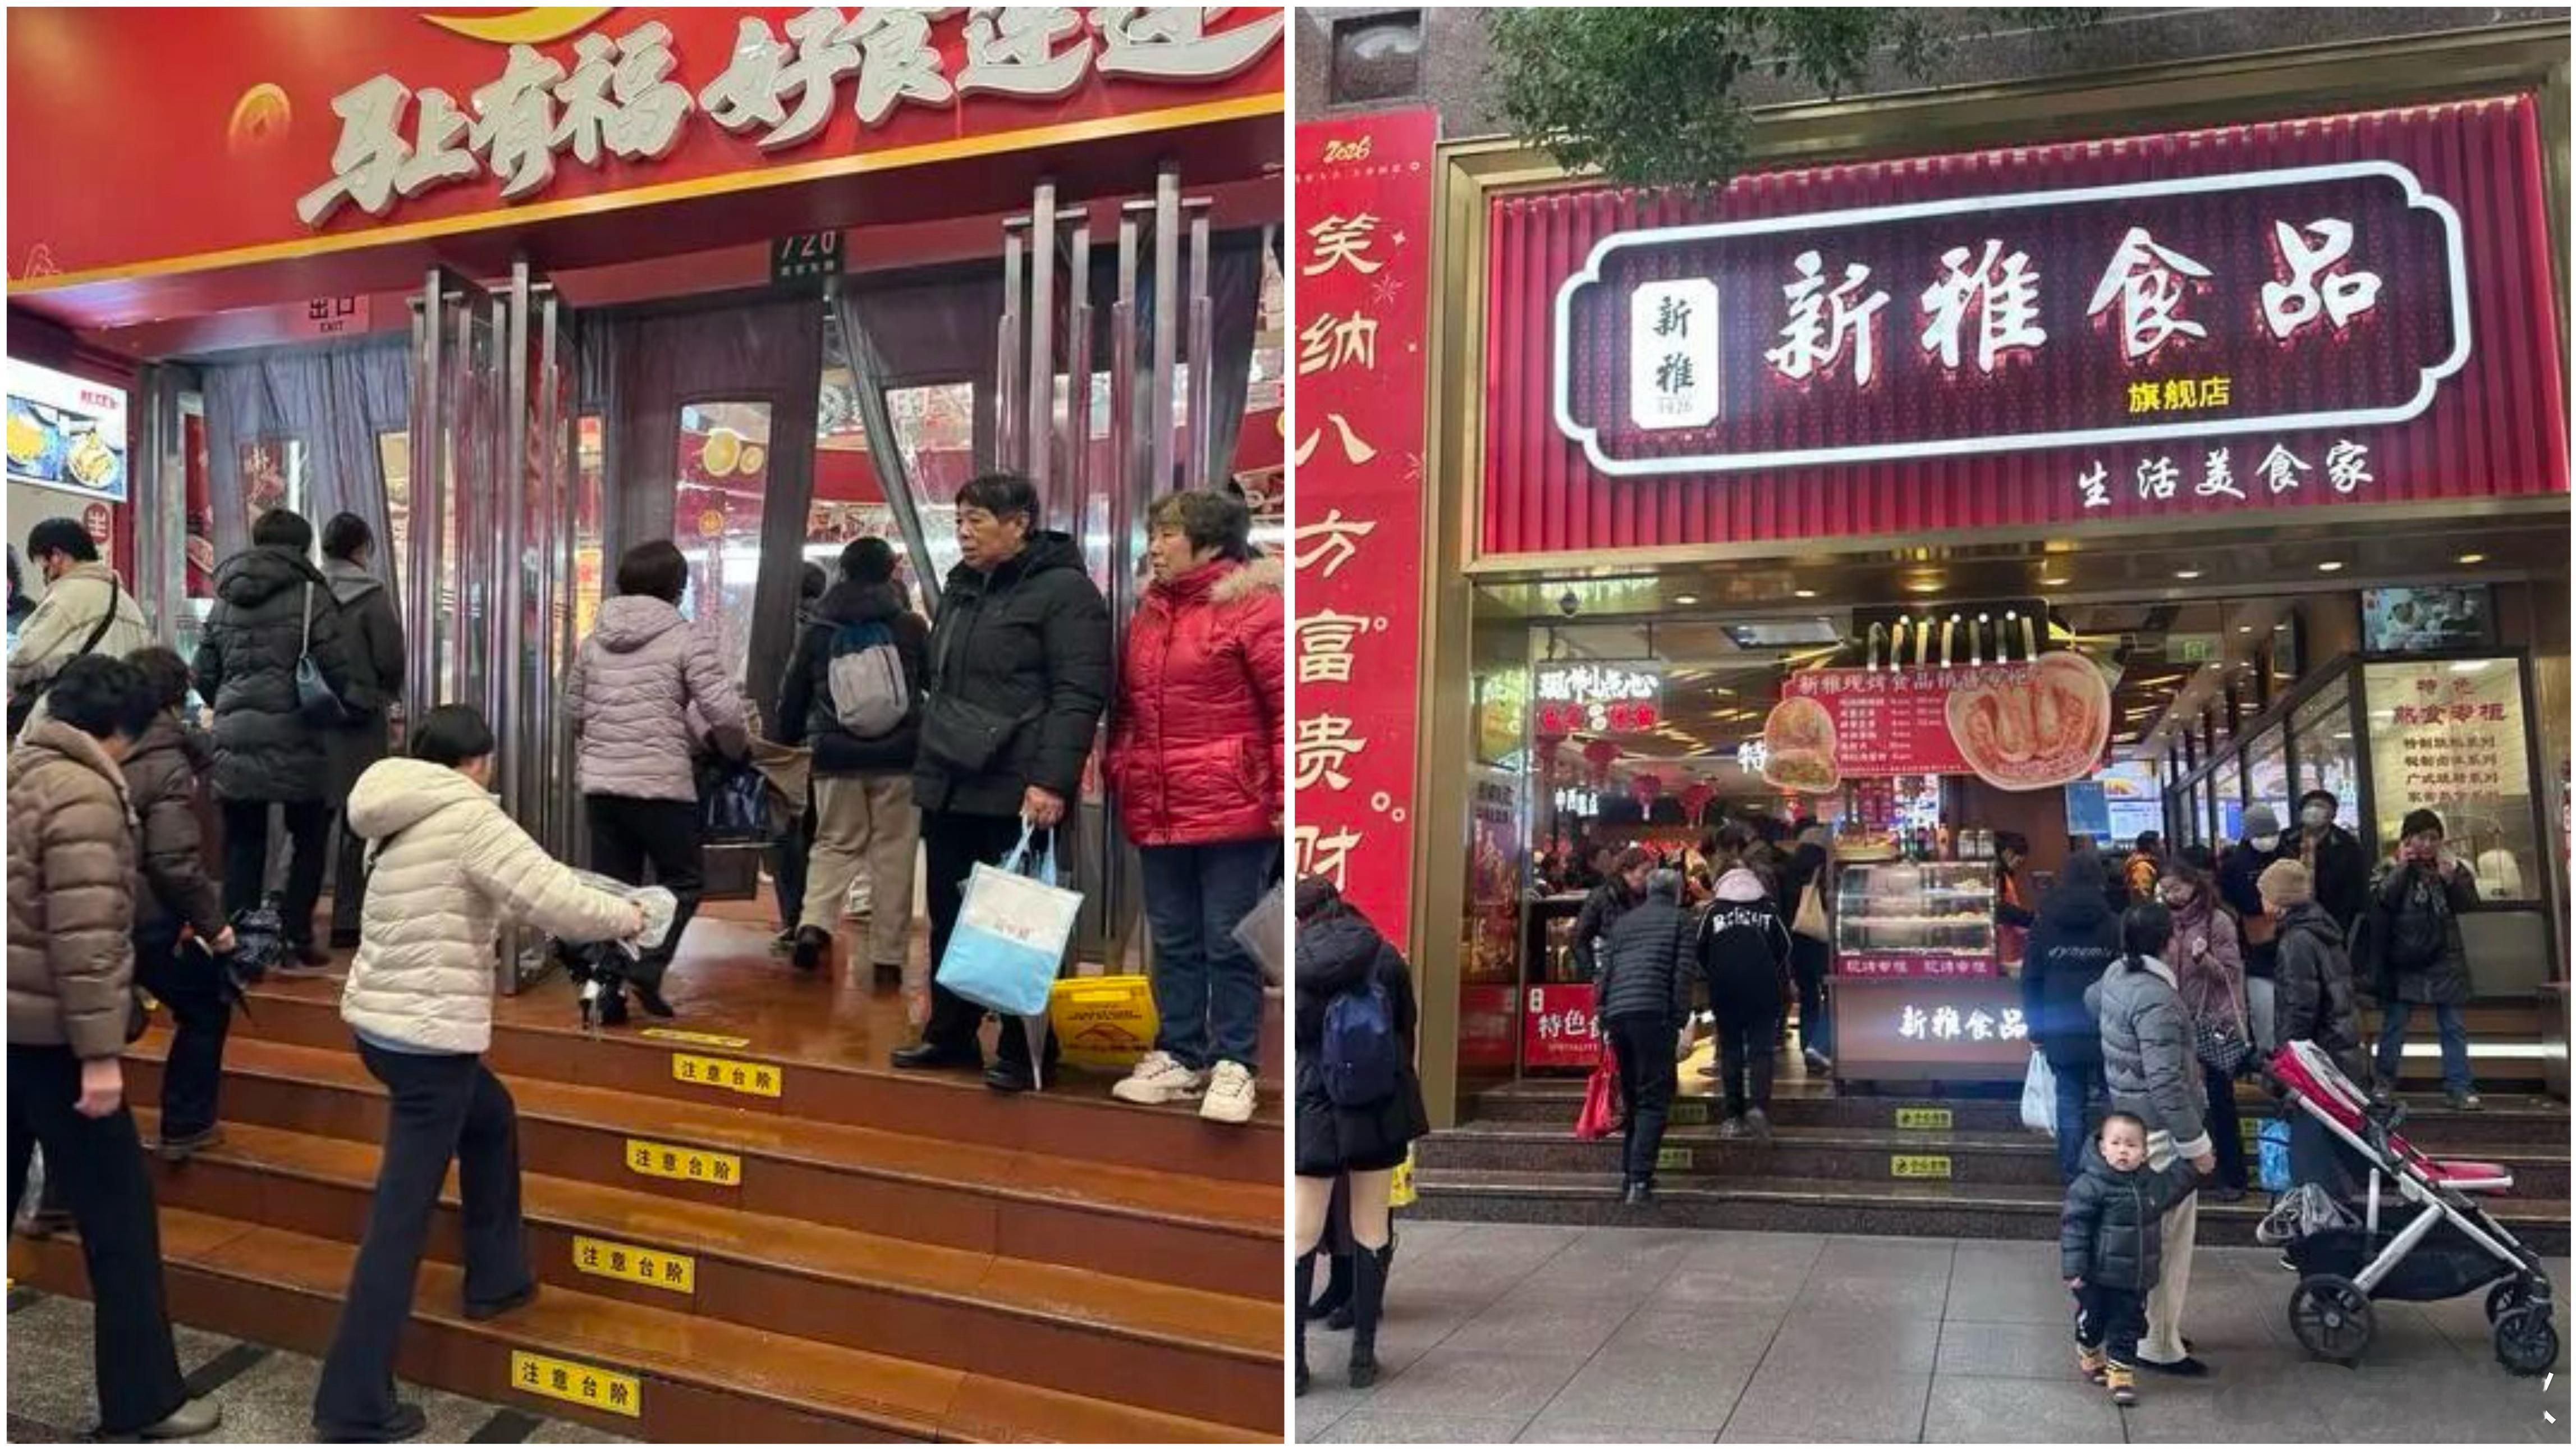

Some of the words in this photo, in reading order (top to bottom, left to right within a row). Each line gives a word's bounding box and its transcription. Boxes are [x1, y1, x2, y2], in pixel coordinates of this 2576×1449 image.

[296, 20, 695, 226] 马上有福
[1323, 135, 1370, 163] 2026
[309, 294, 355, 318] 出口
[1764, 218, 2382, 387] 新雅食品
[1653, 295, 1695, 394] 新雅
[2128, 375, 2231, 413] 旗舰店
[2079, 439, 2373, 508] 生活美食家
[1898, 1004, 2028, 1041] 新雅食品
[681, 1061, 772, 1089] 注意台阶
[635, 1149, 731, 1181] 注意台阶
[583, 1245, 683, 1283] 注意台阶
[522, 1361, 638, 1405] 注意台阶
